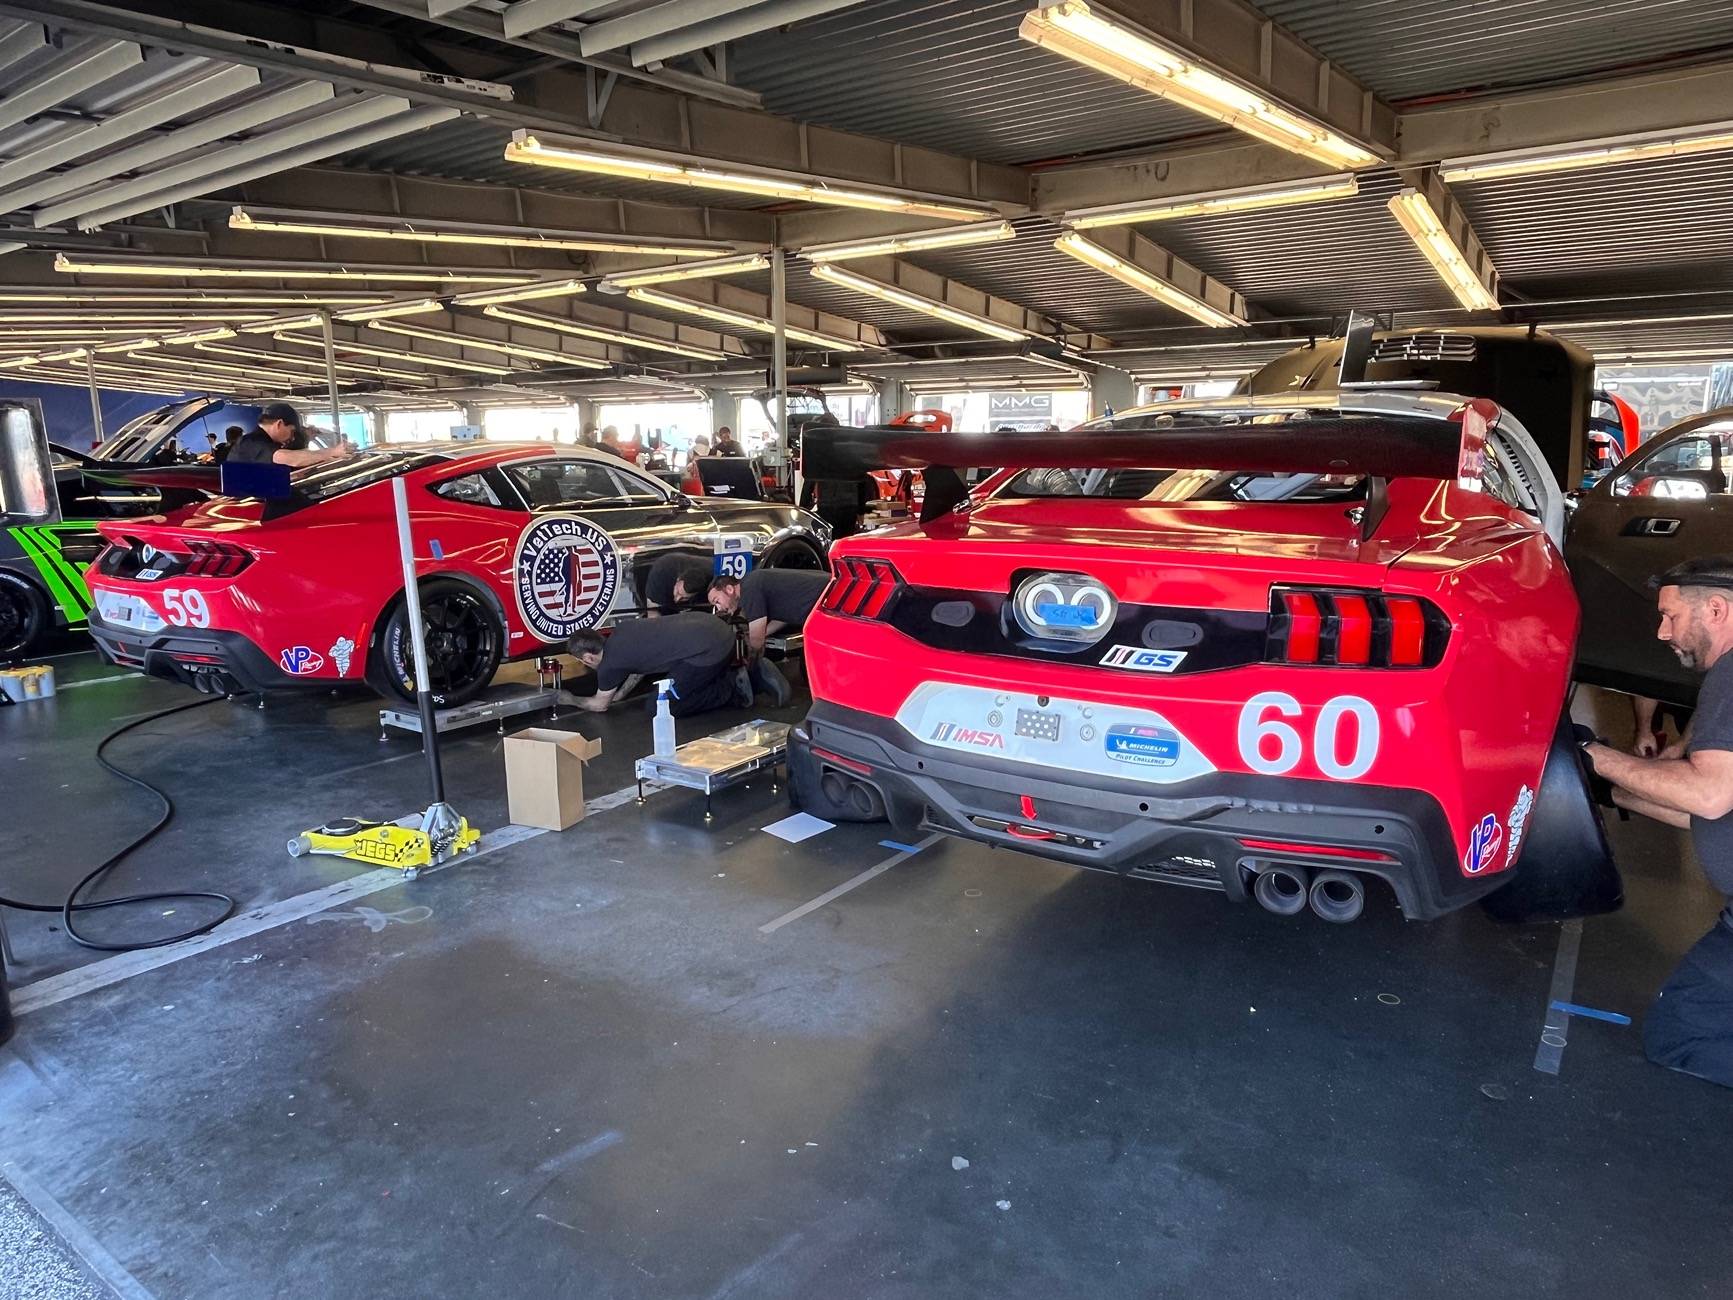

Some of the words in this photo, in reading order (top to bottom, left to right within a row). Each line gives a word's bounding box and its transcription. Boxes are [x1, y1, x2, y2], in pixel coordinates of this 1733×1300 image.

[991, 396, 1049, 408] MMG
[721, 555, 747, 580] 59
[163, 588, 210, 629] 59
[521, 576, 541, 620] SERVING
[536, 617, 564, 636] UNITED
[565, 614, 594, 635] STATES
[592, 568, 615, 616] VETERANS
[281, 645, 312, 674] VP
[1133, 652, 1178, 667] GS
[952, 728, 1004, 749] IMSA
[1129, 742, 1169, 753] MICHELIN
[1237, 691, 1381, 780] 60
[356, 839, 396, 862] JEGS
[1471, 813, 1496, 871] VP
